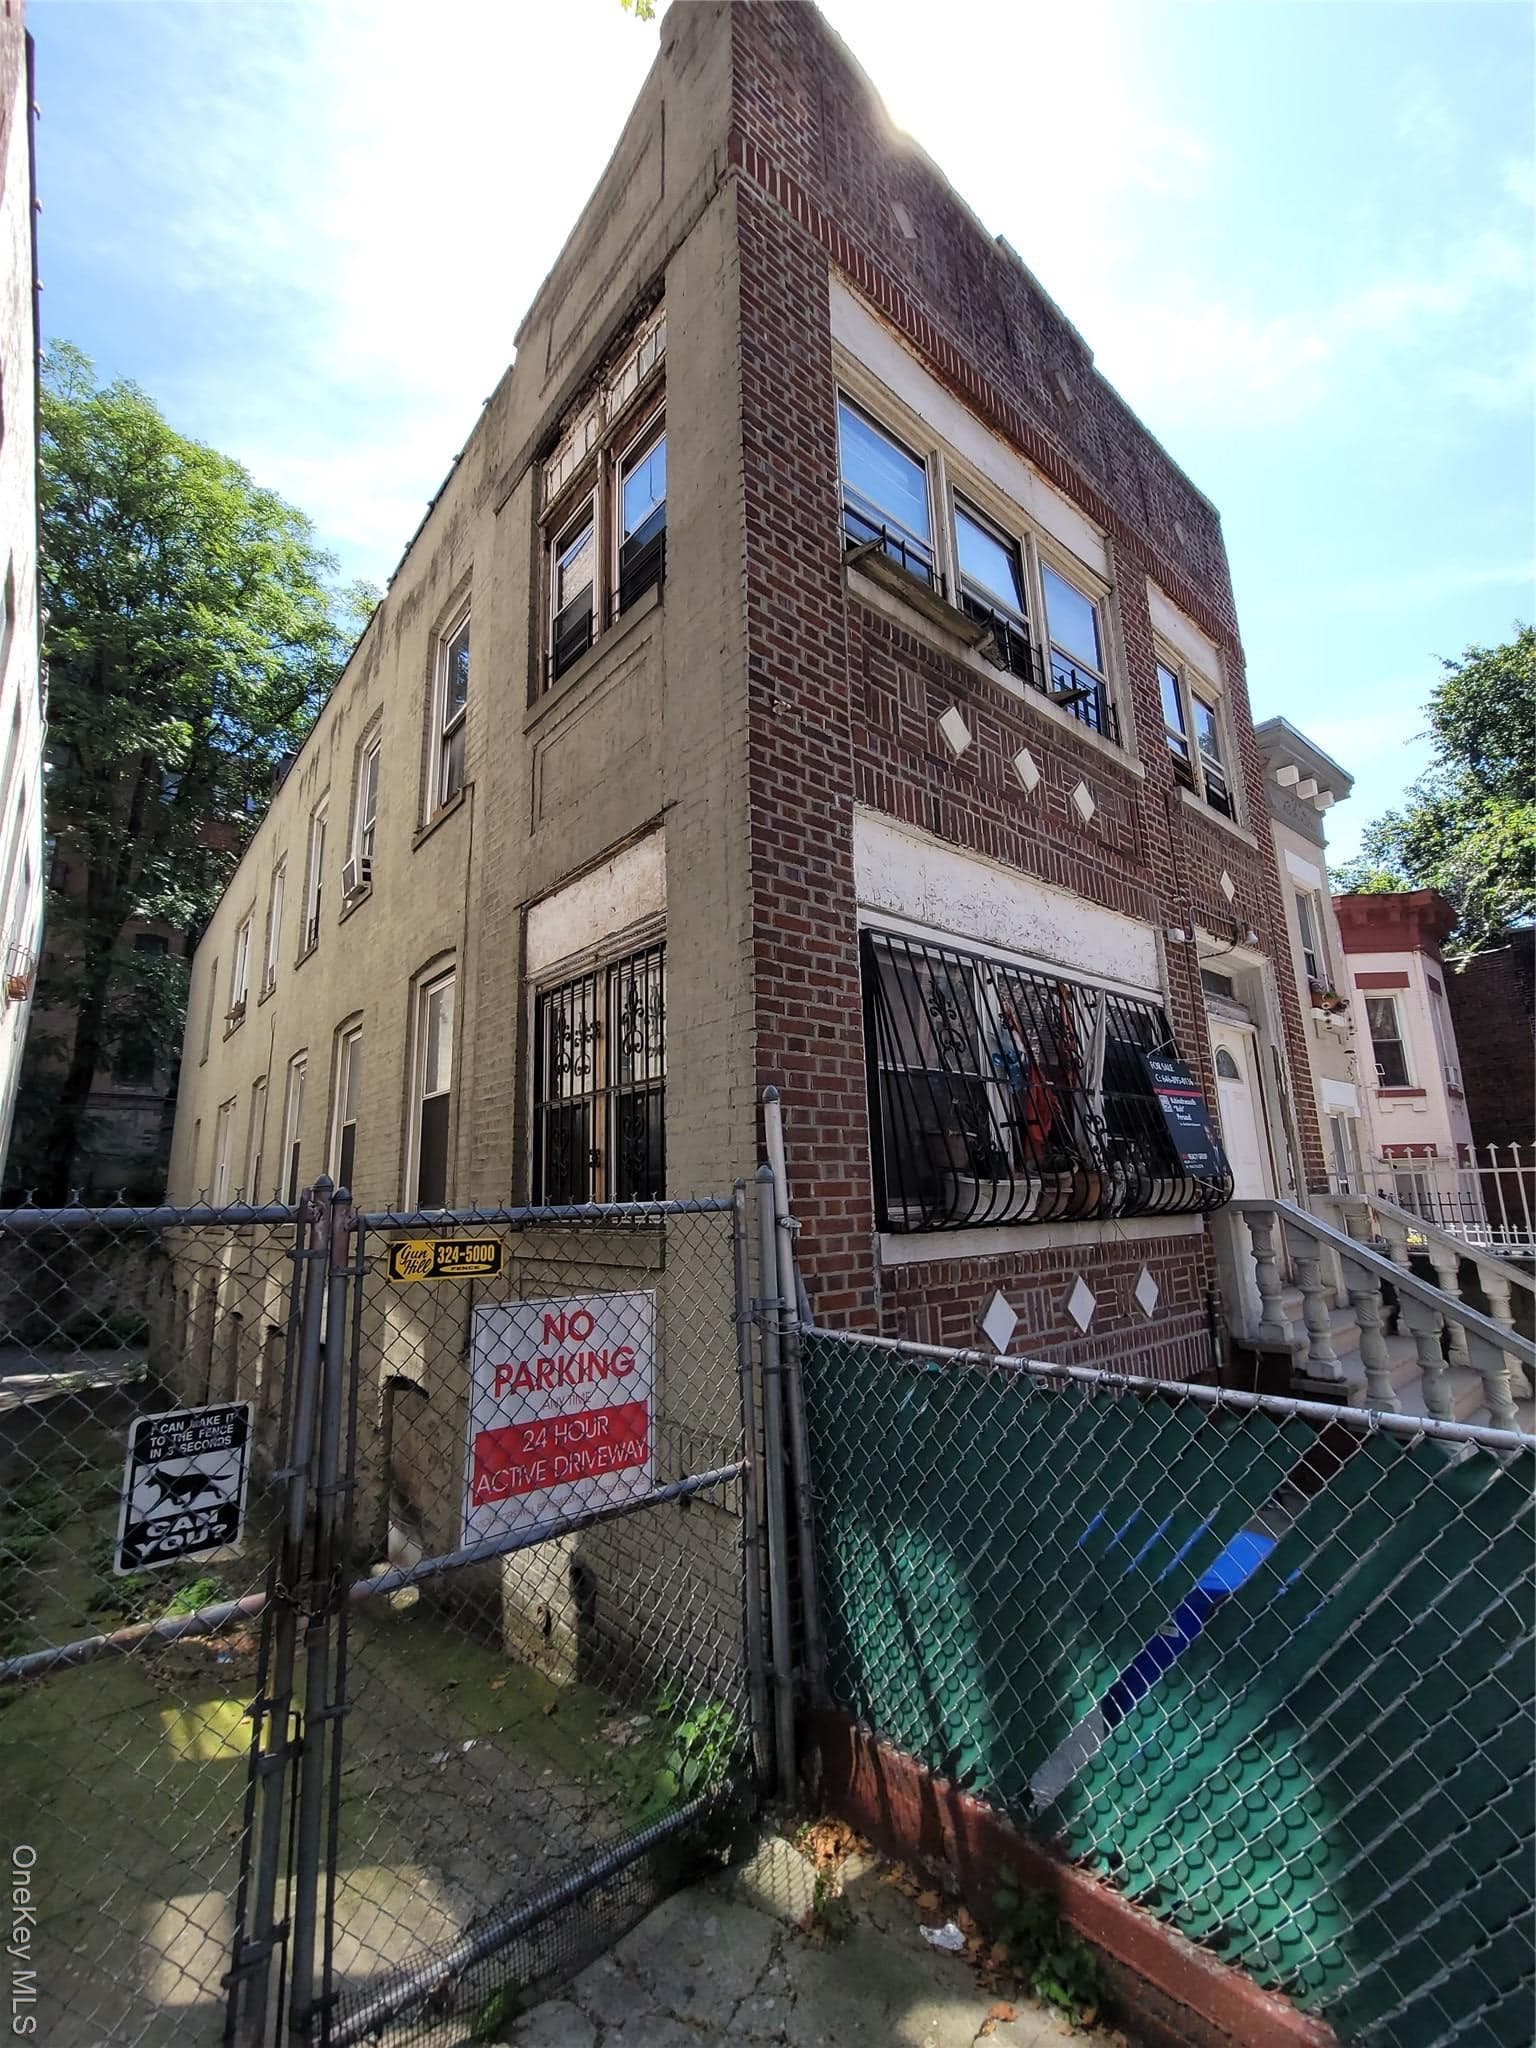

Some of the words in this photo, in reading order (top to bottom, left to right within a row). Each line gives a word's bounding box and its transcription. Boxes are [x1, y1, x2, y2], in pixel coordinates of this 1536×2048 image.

[1149, 1061, 1162, 1070] FOR
[1162, 1063, 1175, 1072] SALE
[400, 1245, 427, 1263] Gun
[437, 1244, 495, 1264] 324-5000
[402, 1258, 432, 1275] Hill
[542, 1309, 595, 1345] NO
[494, 1346, 636, 1398] PARKING
[543, 1396, 565, 1410] ANY
[160, 1421, 185, 1434] CAN
[190, 1415, 220, 1429] MAKE
[226, 1413, 236, 1423] IT
[522, 1428, 547, 1452] 24
[554, 1415, 609, 1444] HOUR
[149, 1449, 162, 1459] IN
[180, 1435, 232, 1453] SECONDS
[150, 1437, 166, 1447] TO
[172, 1431, 193, 1444] THE
[199, 1424, 234, 1439] FENCE
[477, 1459, 546, 1494] ACTIVE
[554, 1438, 647, 1476] DRIVEWAY
[146, 1509, 219, 1538] CAN
[135, 1523, 228, 1557] YOU?
